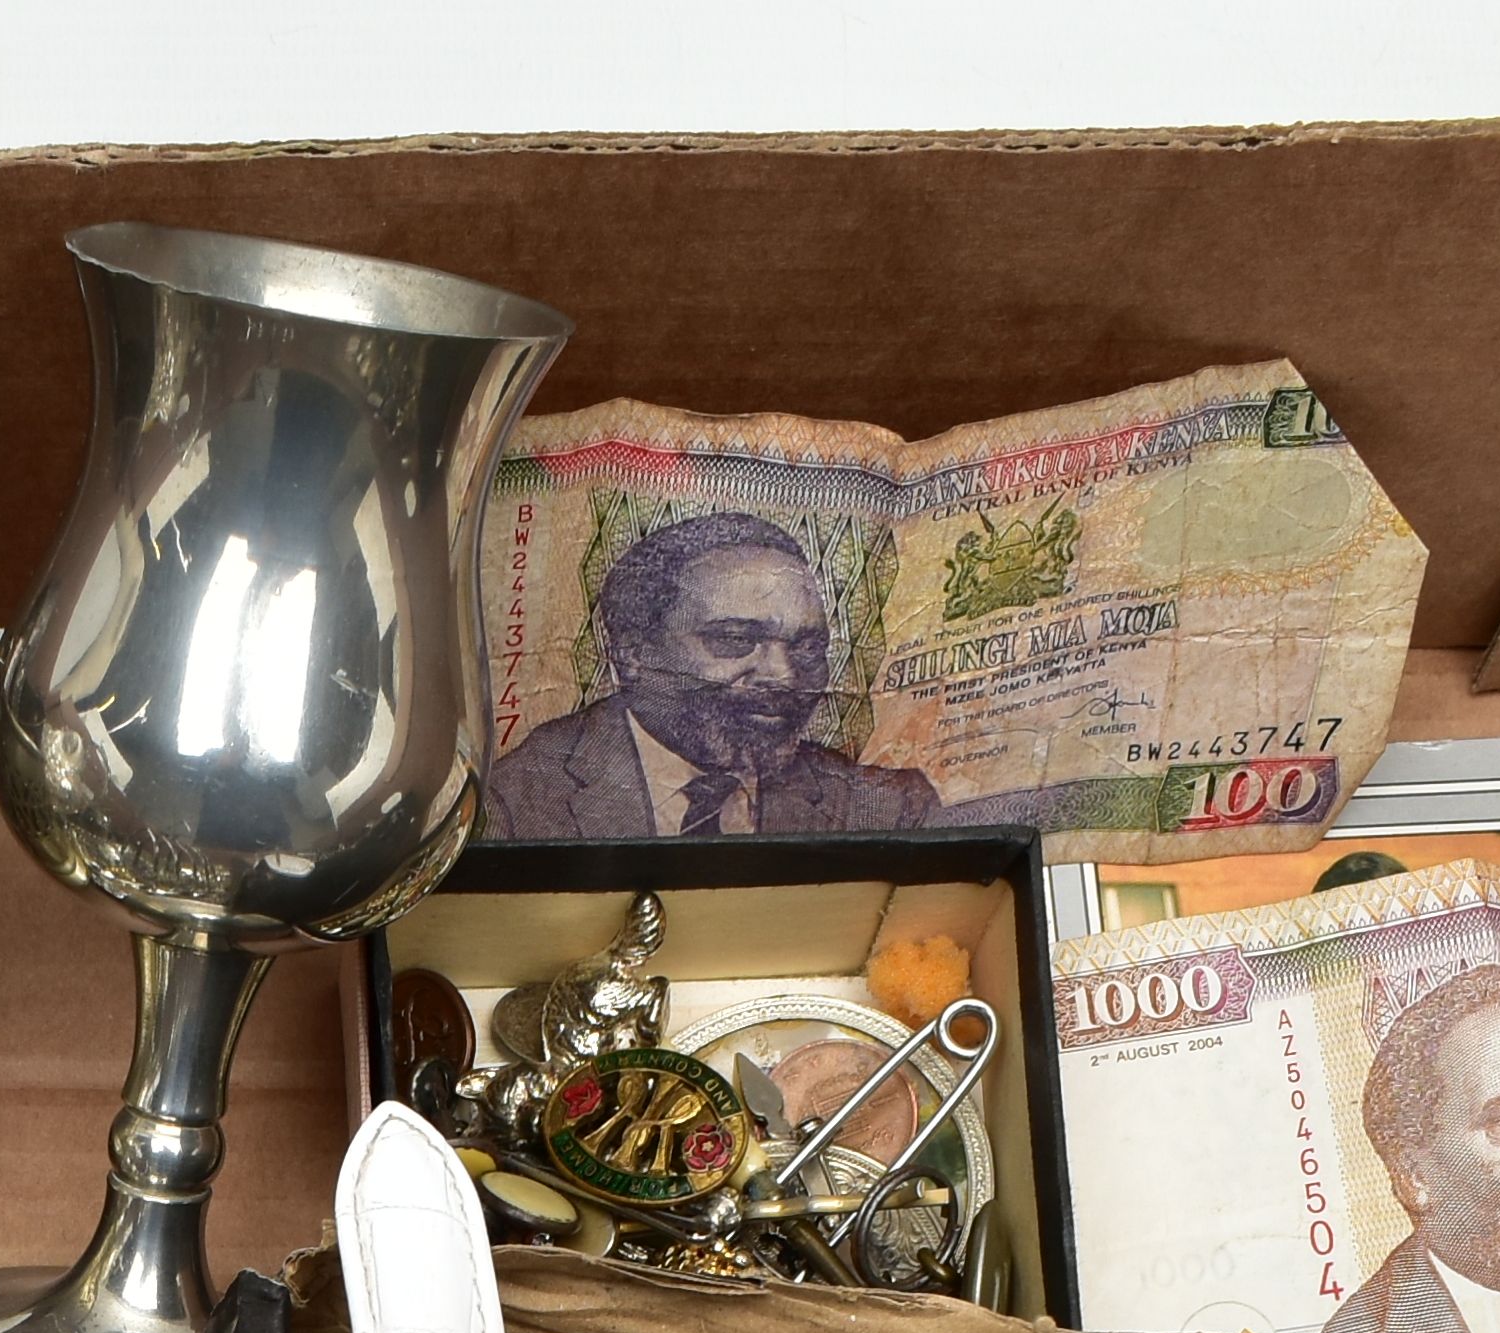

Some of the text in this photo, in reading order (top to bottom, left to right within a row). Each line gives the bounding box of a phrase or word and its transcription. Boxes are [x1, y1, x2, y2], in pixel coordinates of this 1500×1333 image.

[900, 412, 1232, 514] BANKI KUU YA KENYA
[933, 453, 1193, 522] CENTRAL BANK OF KENYA
[496, 503, 533, 747] BW2443747
[884, 599, 1178, 693] SHILINGI MIA MOJA
[890, 583, 1182, 656] LEGAL TENDER FOR ONE HUNDRED SHILLINGS
[911, 638, 1147, 701] THE FIRST PRESIDENT OF KENYA
[945, 691, 982, 707] MZEE
[988, 677, 1032, 696] JOMO
[937, 680, 1109, 729] FOR THE BOARD OF DIRECTORS
[1081, 722, 1136, 739] MEMBER
[941, 744, 1009, 769] GOVERNOR
[1126, 717, 1343, 763] BW2443747
[1176, 764, 1323, 827] 100
[1069, 964, 1224, 1034] 1000
[1116, 1042, 1180, 1064] AUGUST
[1188, 1035, 1223, 1052] 2004
[1277, 1009, 1344, 1301] AZ5046504
